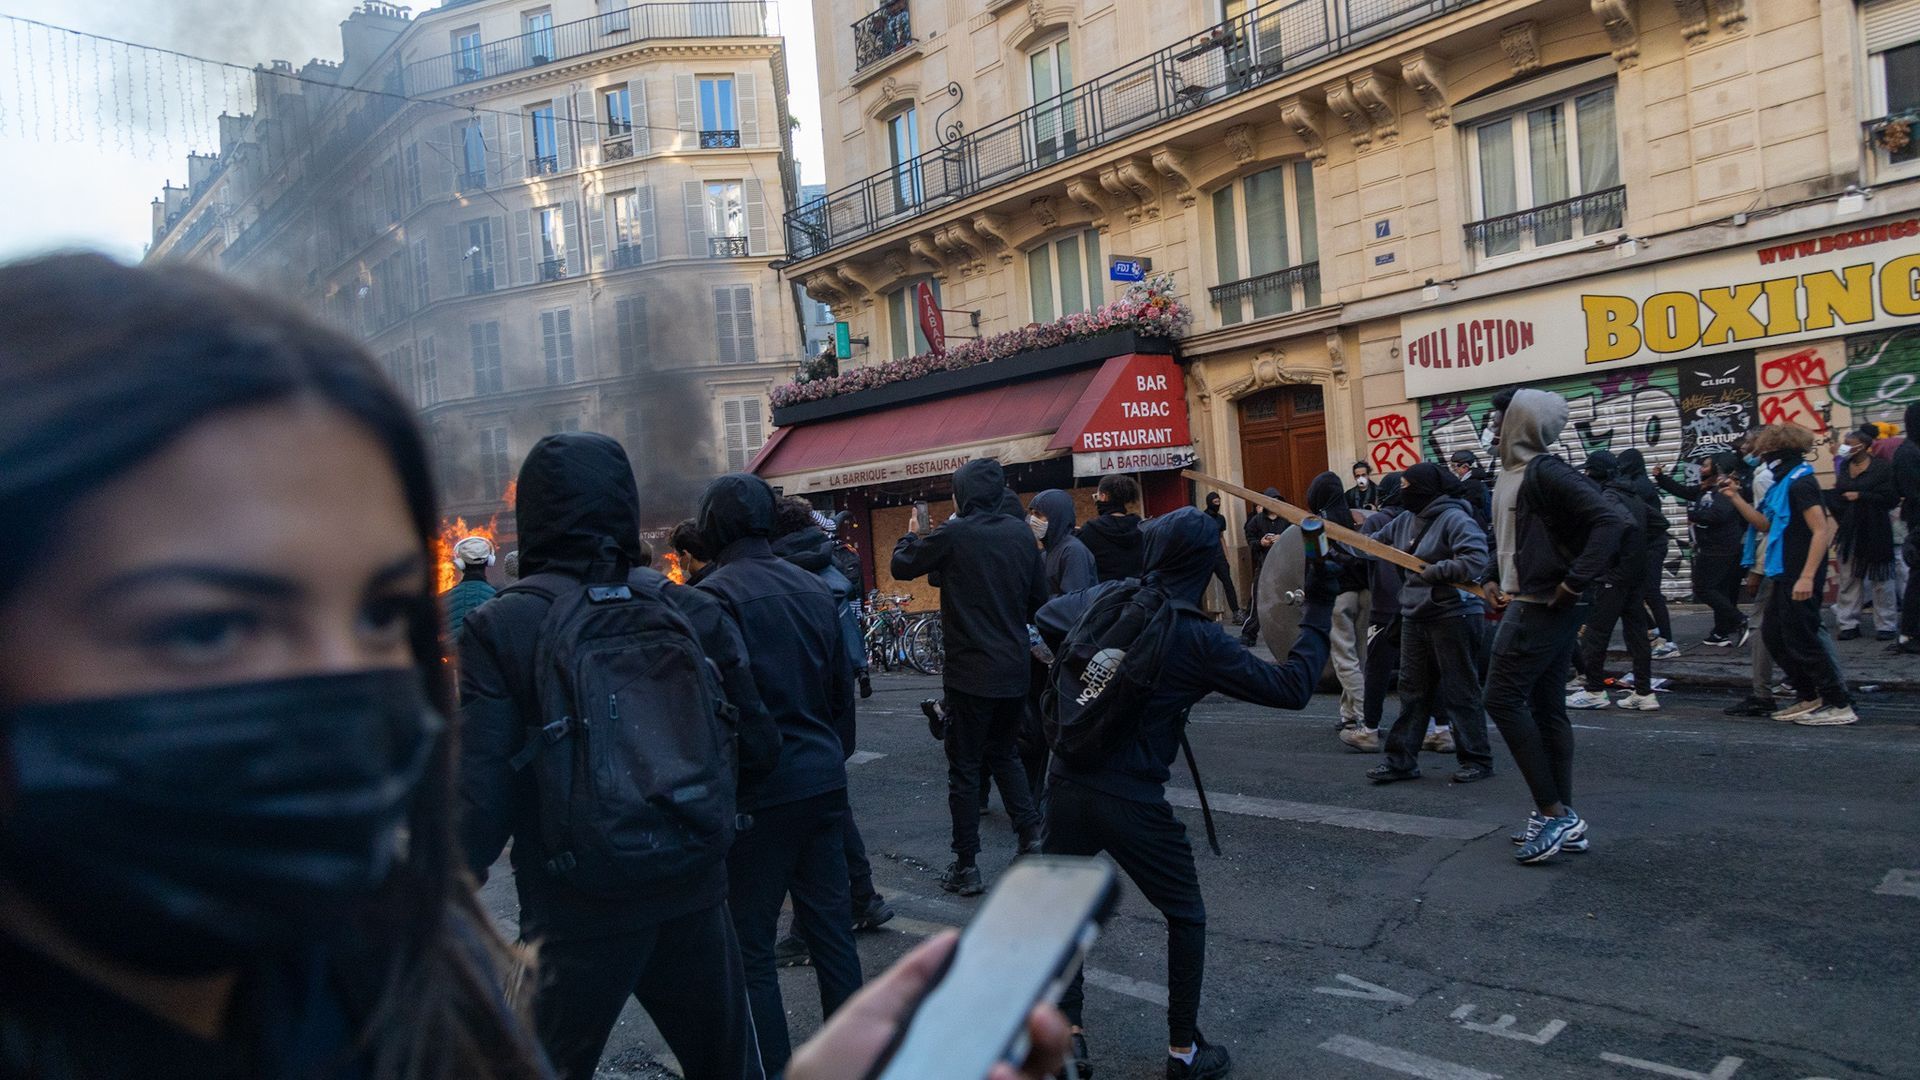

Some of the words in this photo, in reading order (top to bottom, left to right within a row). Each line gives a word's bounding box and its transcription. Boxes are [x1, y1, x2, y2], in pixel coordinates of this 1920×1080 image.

[1378, 222, 1387, 236] 7
[1757, 219, 1920, 265] WWW.BOXINGS
[1117, 263, 1130, 272] FDJ
[1581, 253, 1920, 364] BOXING
[923, 294, 944, 351] TABAC
[1408, 328, 1452, 368] FULL
[1457, 319, 1534, 368] ACTION
[1137, 375, 1167, 391] BAR
[1121, 401, 1170, 418] TABAC
[1083, 428, 1172, 449] RESTAURANT
[1101, 457, 1114, 470] LA
[1118, 453, 1174, 469] BARRIQUE
[829, 474, 841, 486] LA
[843, 468, 887, 484] BARRIQUE
[1080, 661, 1099, 683] THE
[1076, 666, 1109, 706] NORTH
